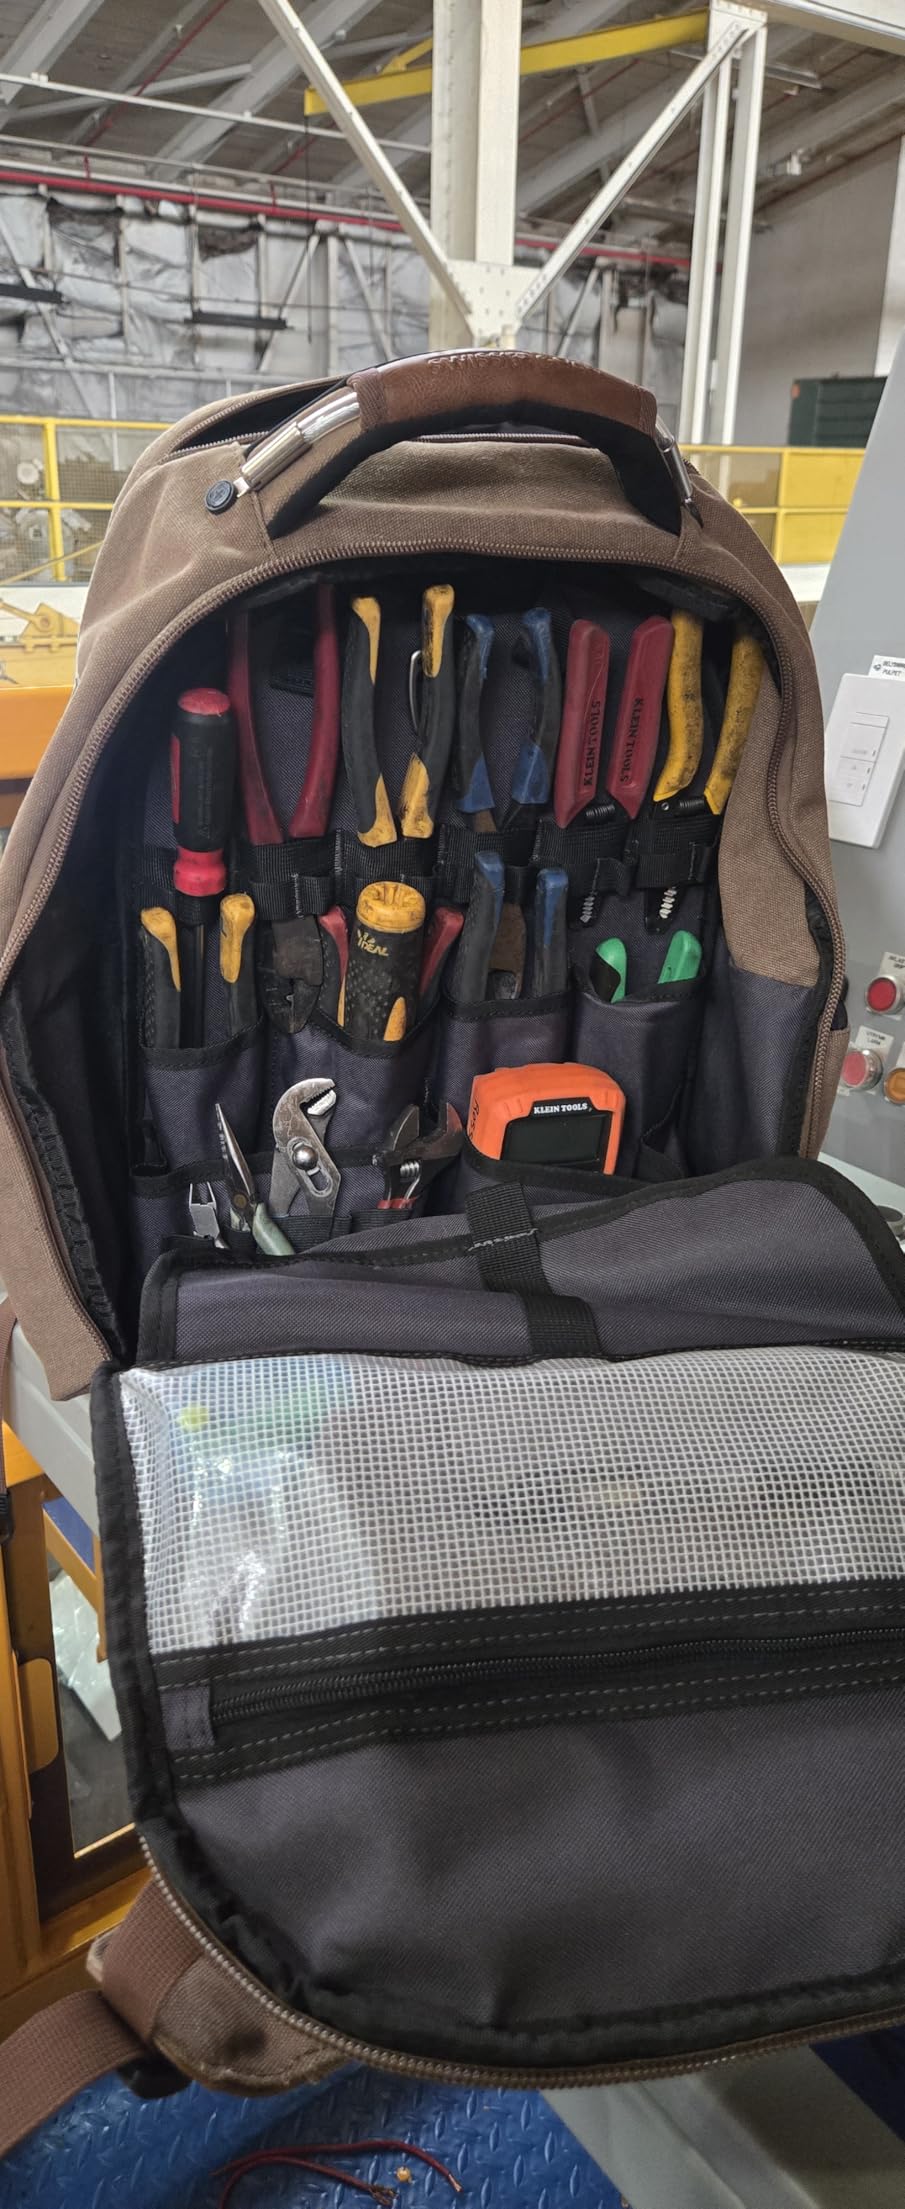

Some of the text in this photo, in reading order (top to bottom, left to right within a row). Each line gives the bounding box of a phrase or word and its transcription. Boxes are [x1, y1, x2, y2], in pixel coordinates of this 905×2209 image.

[583, 701, 601, 786] KLEIN TOOLS
[620, 698, 645, 782] KLEIN TOOLS
[533, 1102, 588, 1115] KLEIN TOOLS
